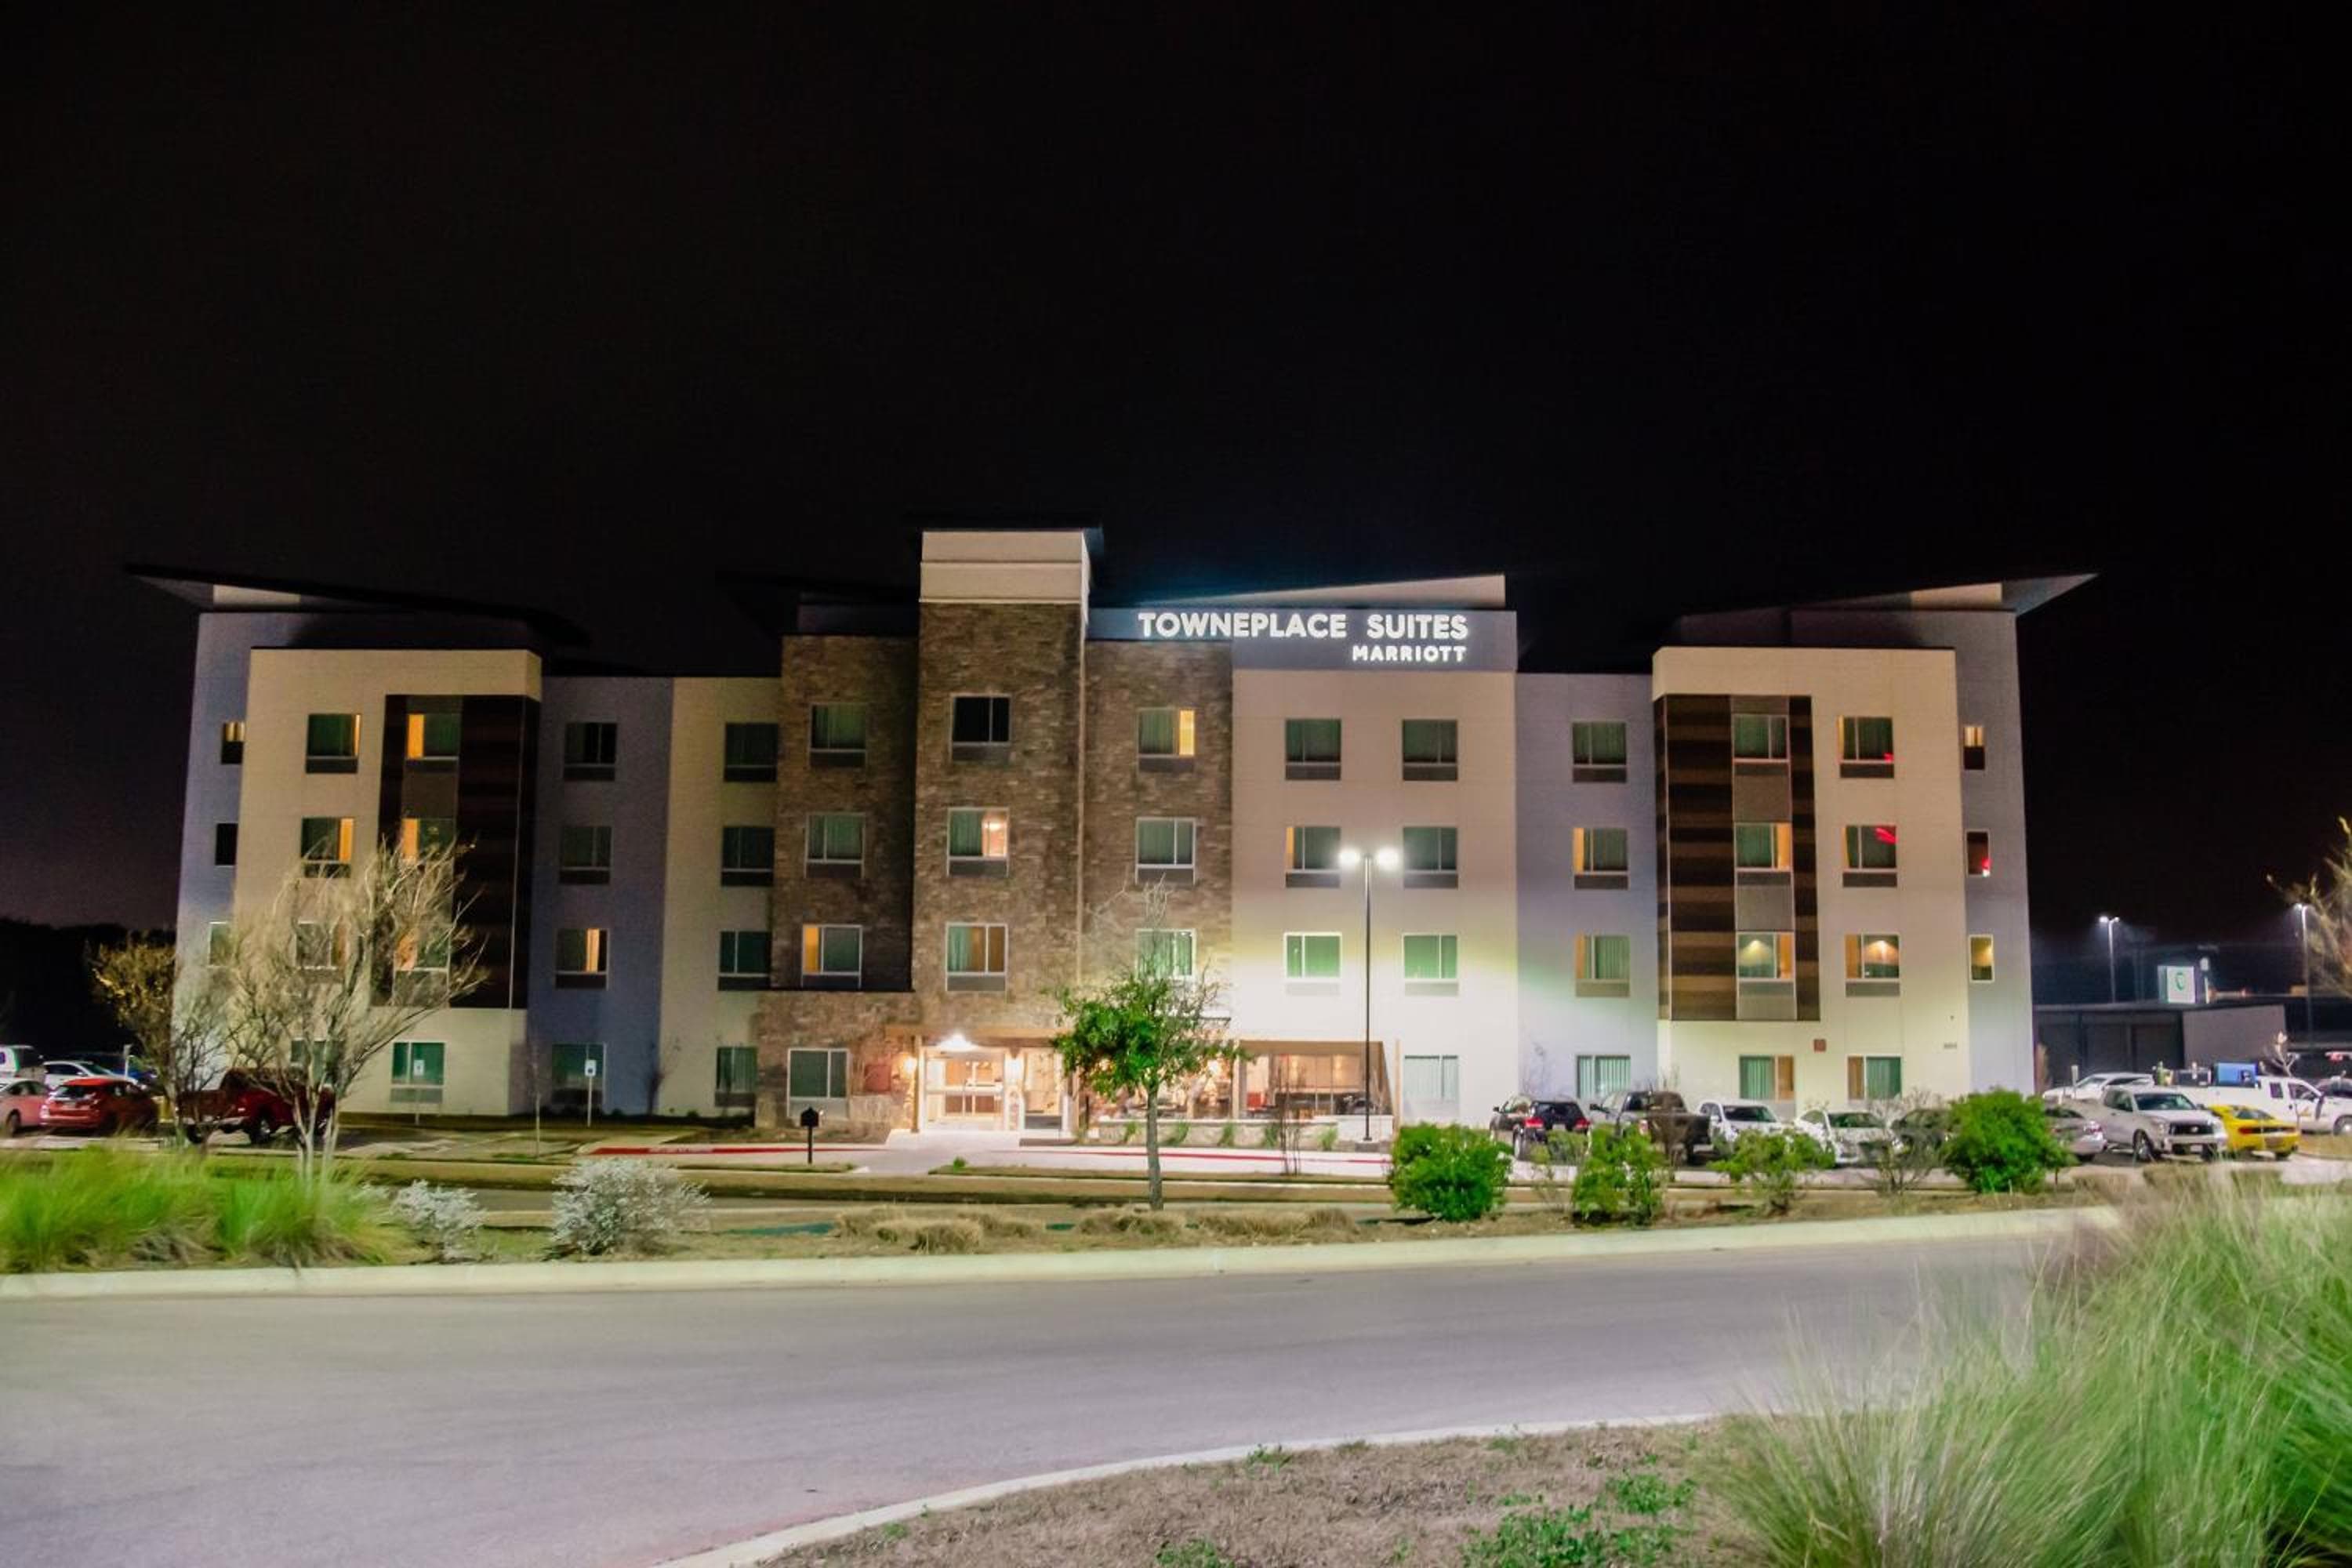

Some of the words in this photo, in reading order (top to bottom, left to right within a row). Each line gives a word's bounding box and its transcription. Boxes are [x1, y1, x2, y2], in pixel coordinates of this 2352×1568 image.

[1138, 612, 1347, 638] TOWNEPLACE
[1367, 613, 1468, 639] SUITES
[1352, 644, 1466, 662] MARRIOTT
